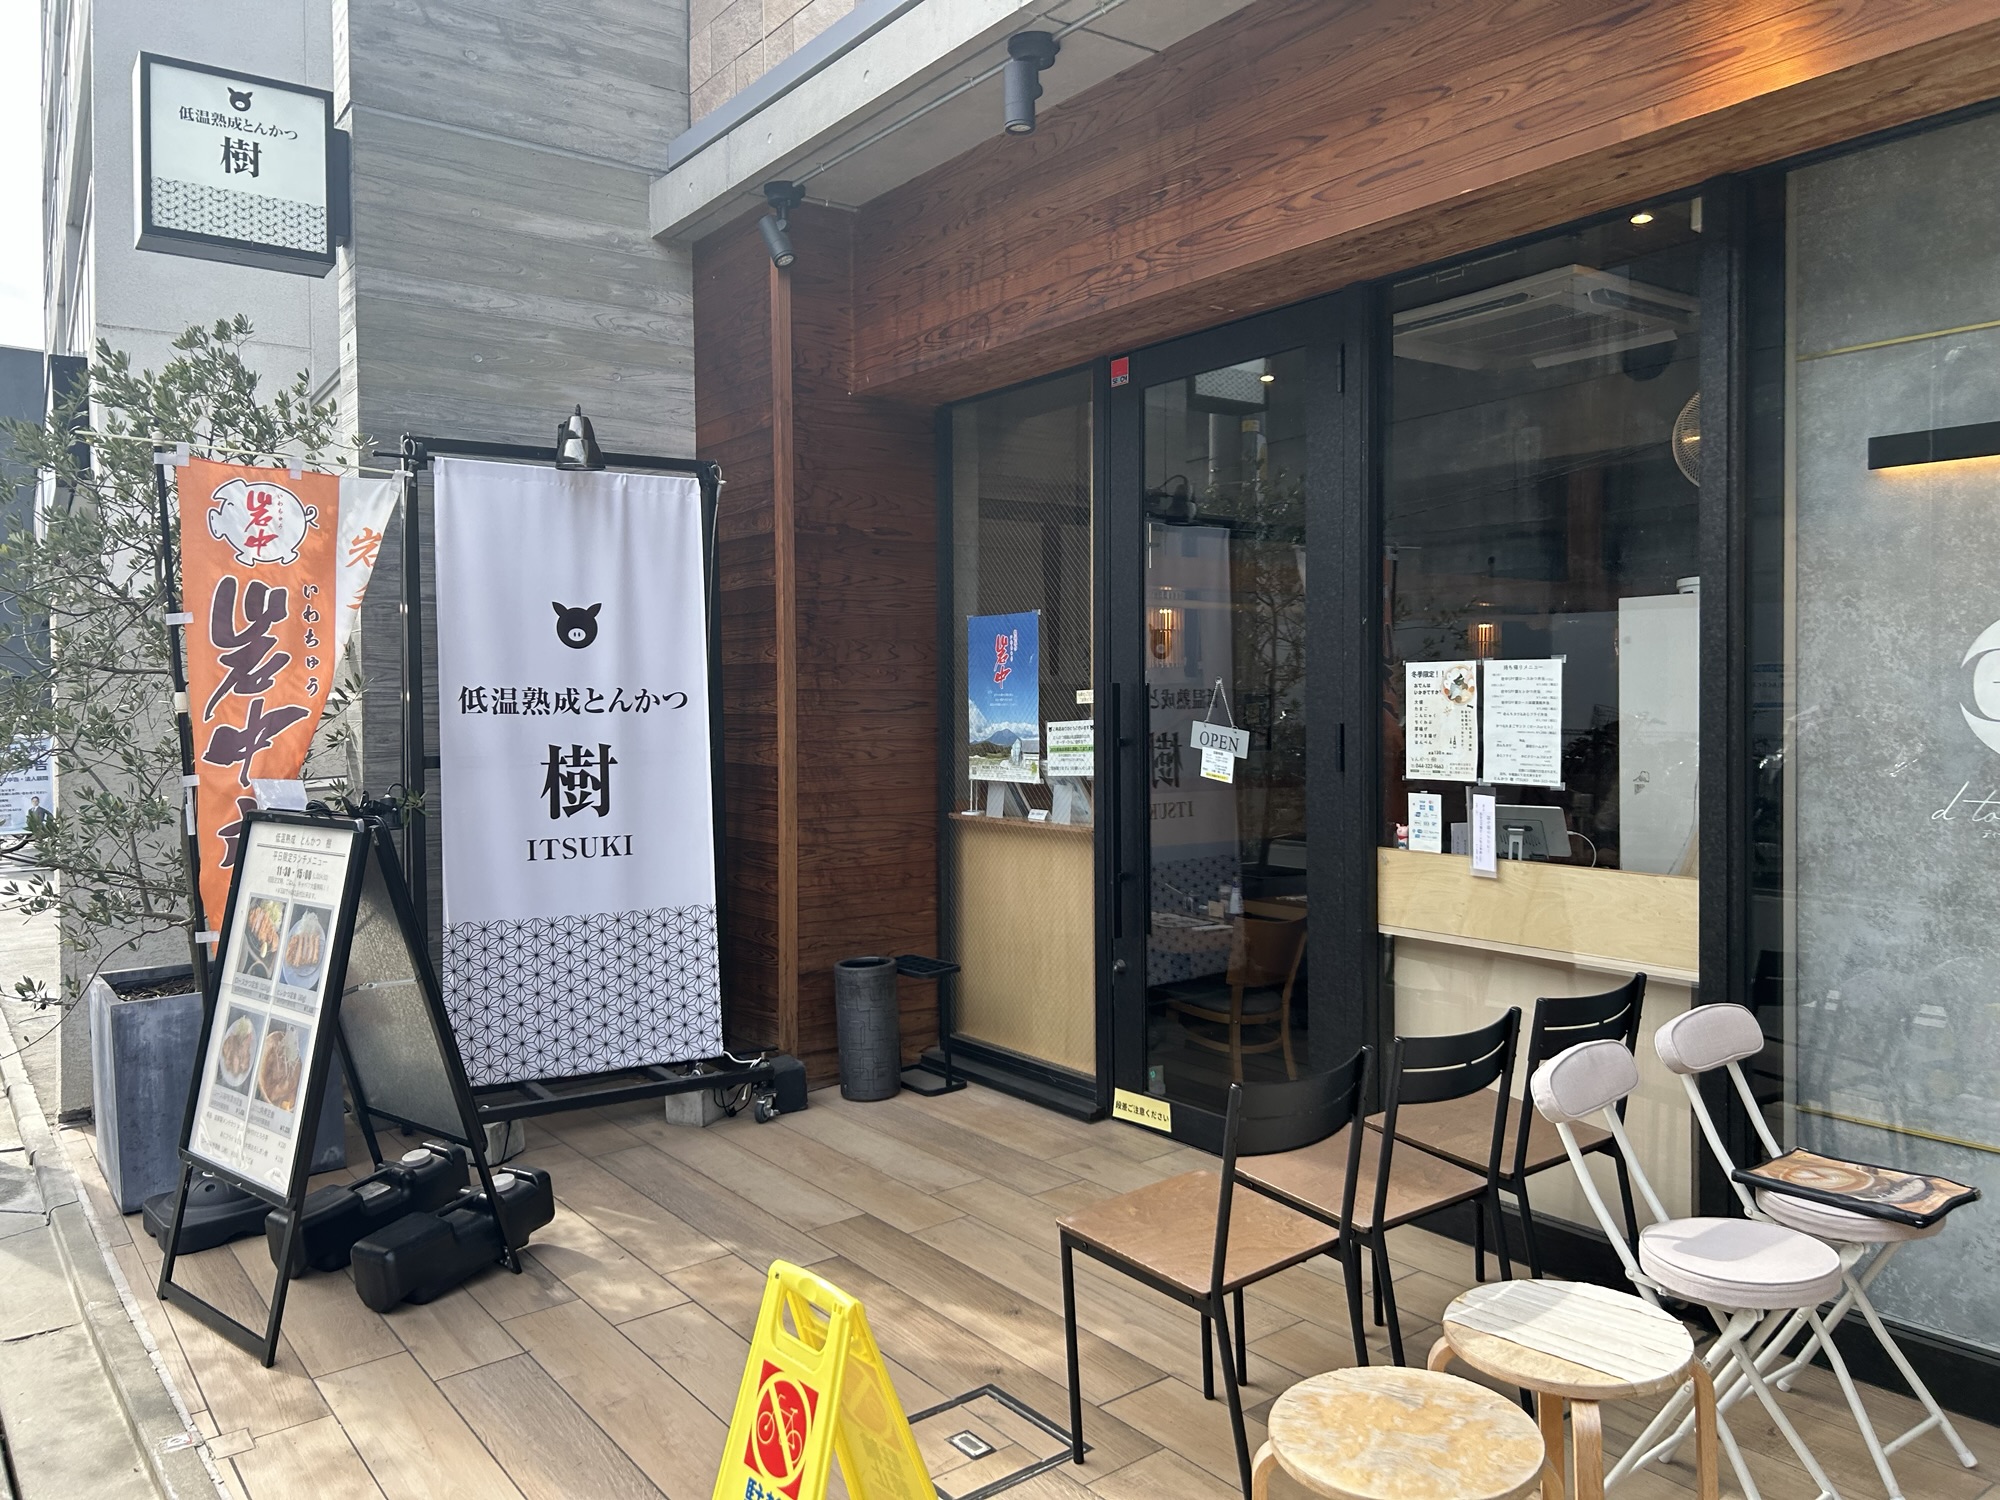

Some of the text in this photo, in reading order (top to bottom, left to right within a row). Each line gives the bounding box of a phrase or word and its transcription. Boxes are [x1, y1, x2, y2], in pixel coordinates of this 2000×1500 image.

[178, 105, 298, 140] 低温熟成とんかつ
[220, 136, 262, 178] 樹
[244, 490, 278, 557] 岩中
[303, 584, 320, 697] いわちゅう
[457, 685, 689, 716] 低温熟成とんかつ
[1199, 730, 1240, 753] OPEN
[540, 743, 619, 820] 樹
[526, 834, 634, 862] ITSUKI
